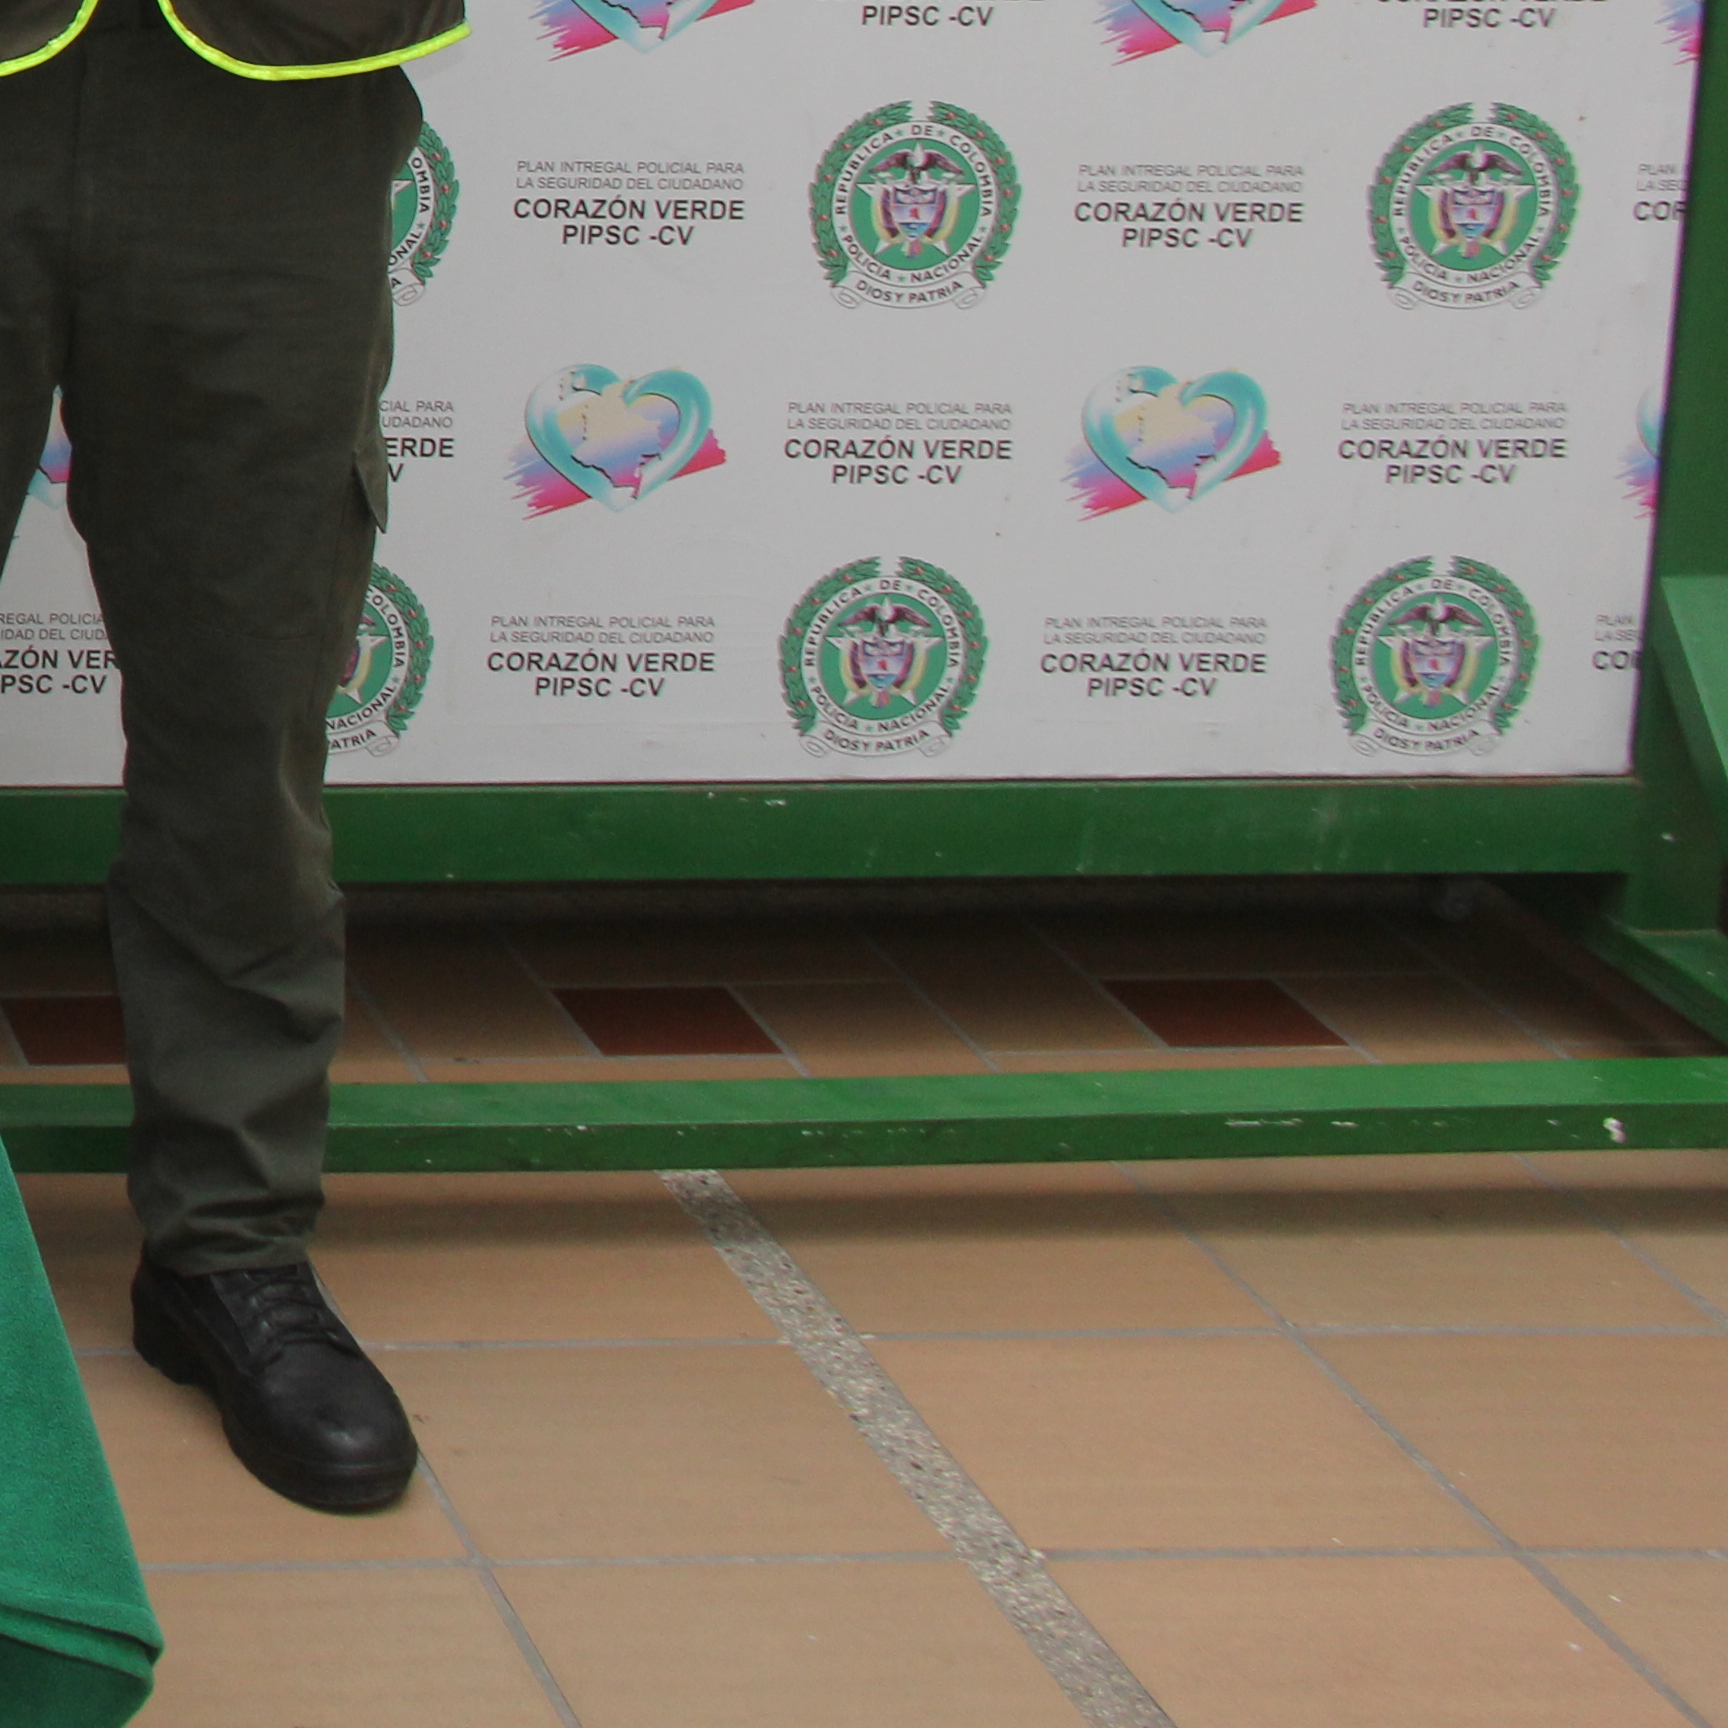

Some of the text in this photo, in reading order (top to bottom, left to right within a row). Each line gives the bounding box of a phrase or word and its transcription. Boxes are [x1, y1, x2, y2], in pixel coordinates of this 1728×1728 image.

[862, 5, 940, 26] PIPSC
[910, 124, 934, 136] DE
[948, 134, 994, 217] COLOMBIA
[910, 236, 982, 283] NACIONAL
[908, 280, 963, 303] PATRIA
[1040, 648, 1268, 674] CORAZÓN VERDE
[1087, 677, 1165, 697] PIPSC
